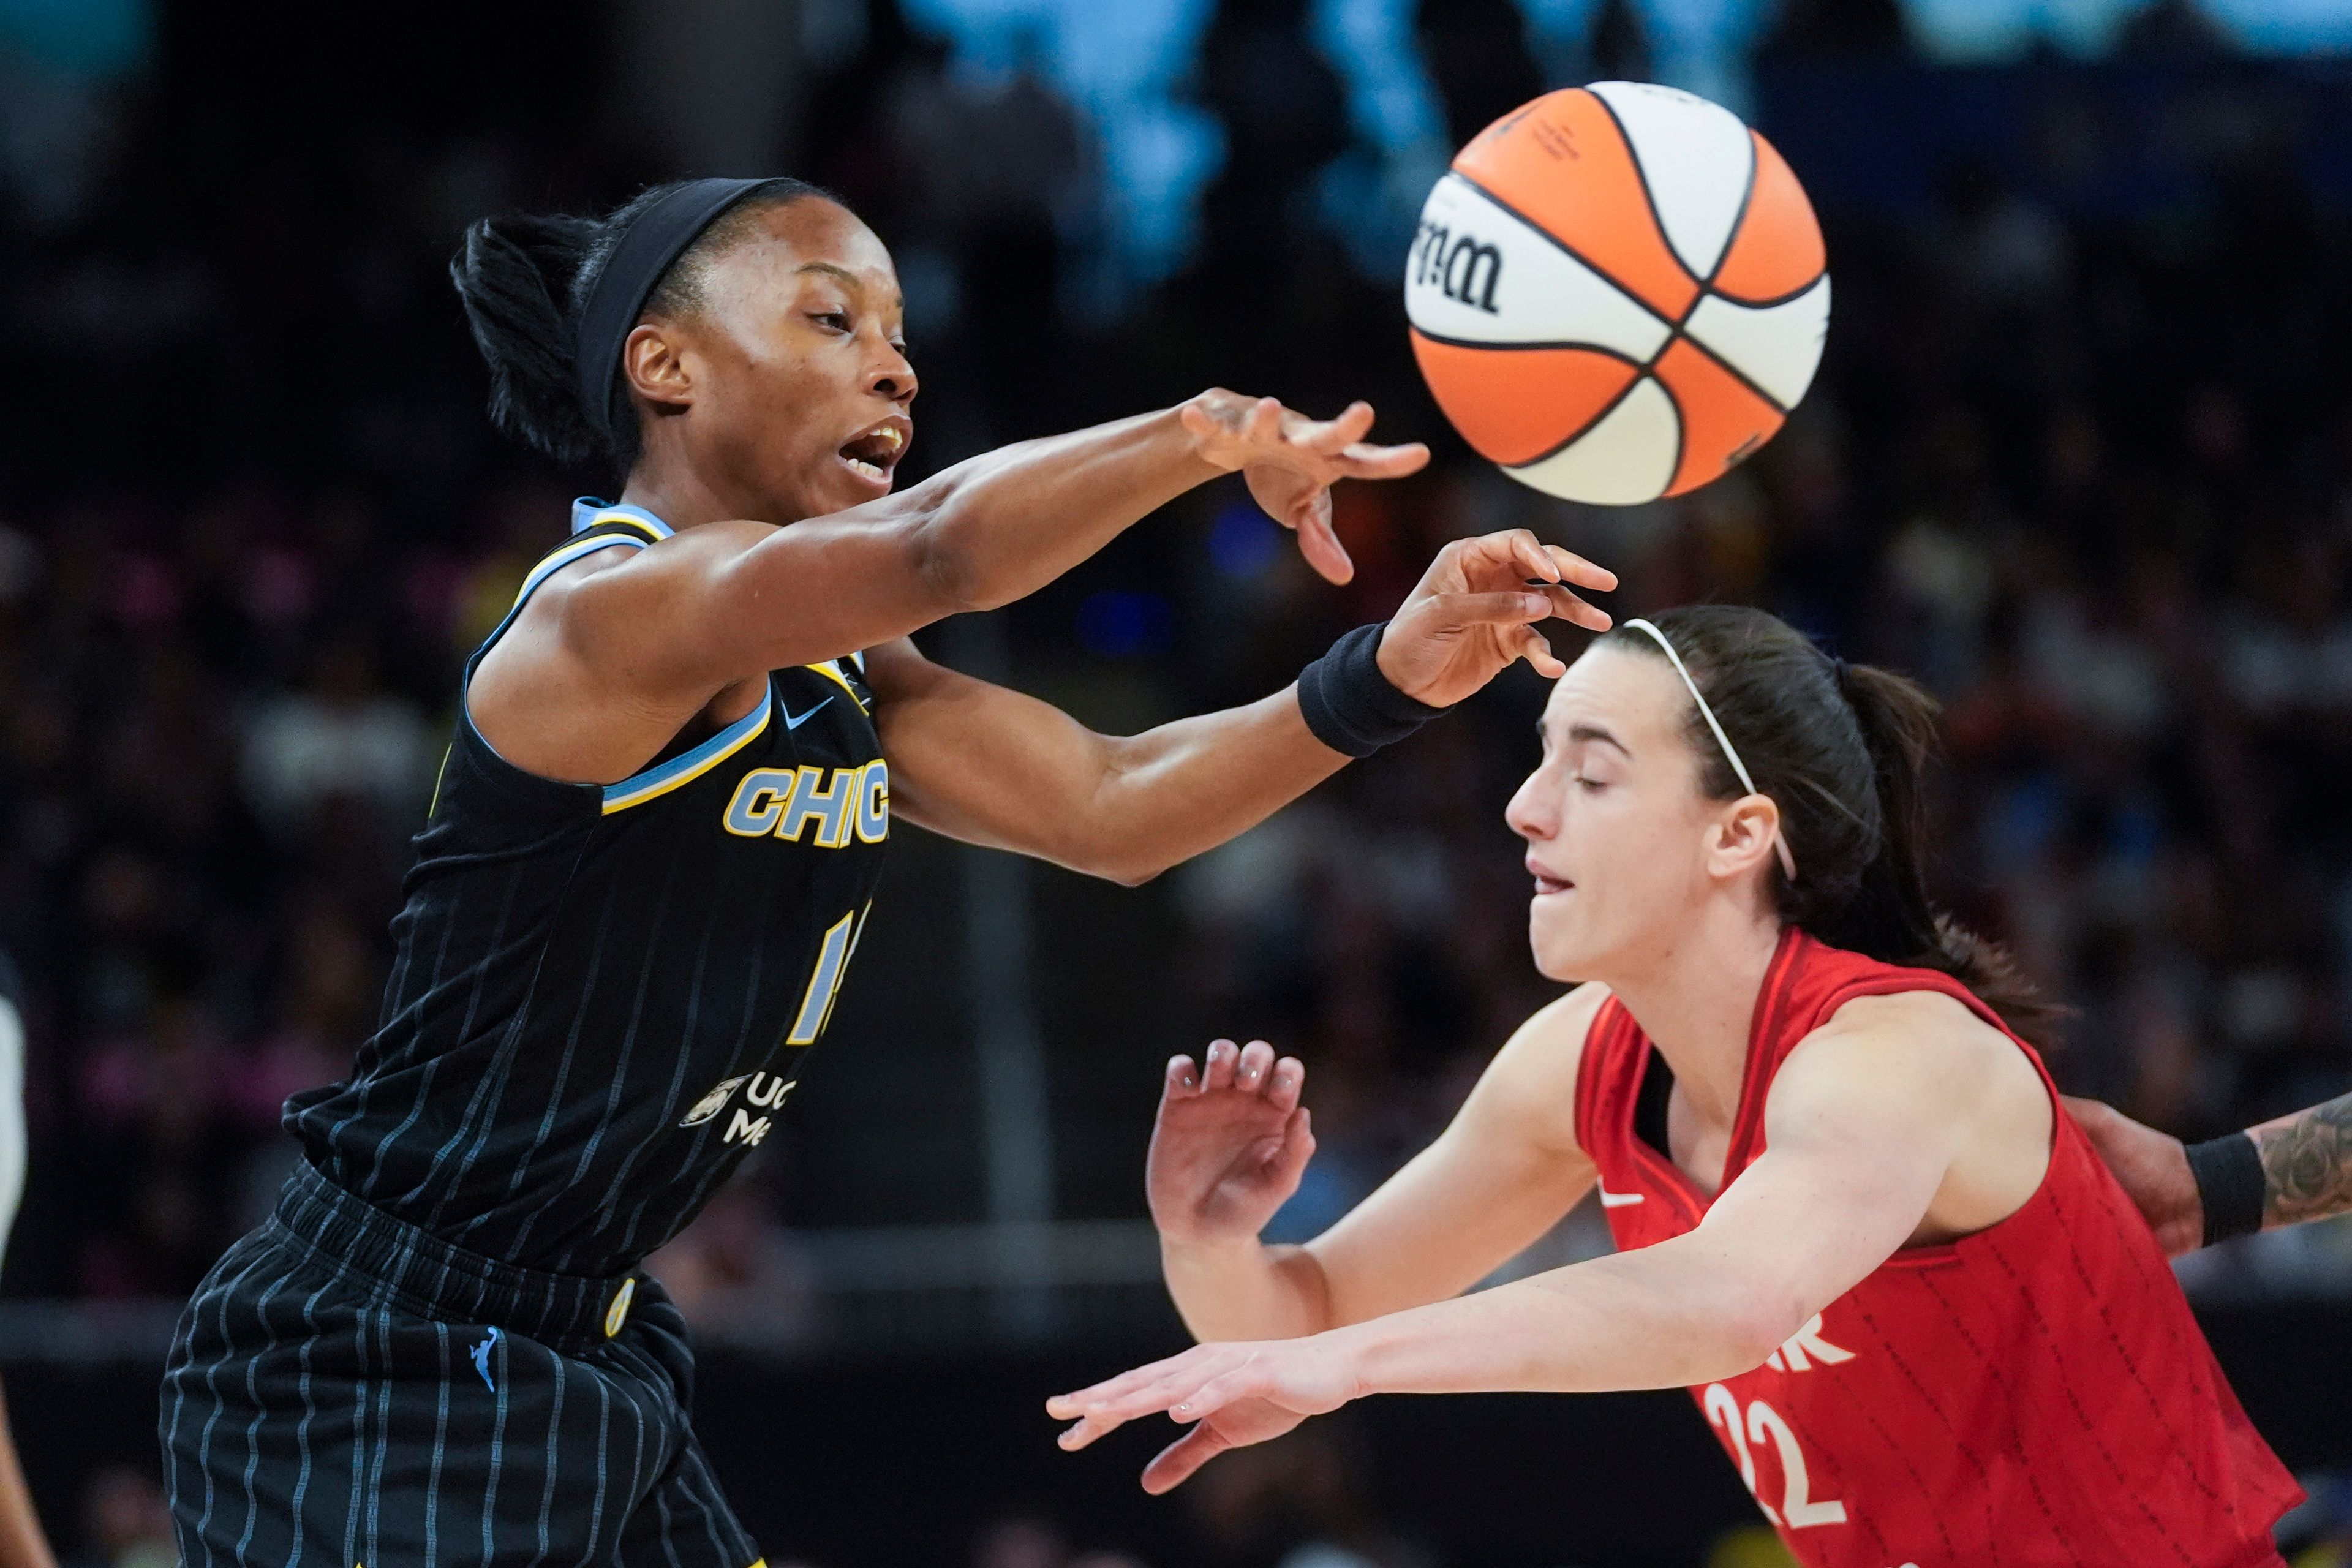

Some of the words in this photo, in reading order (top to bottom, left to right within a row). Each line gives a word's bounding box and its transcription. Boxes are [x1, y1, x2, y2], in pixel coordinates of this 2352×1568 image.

[723, 758, 888, 848] CHIC
[786, 897, 873, 1045] 1
[1705, 1383, 1847, 1529] 22
